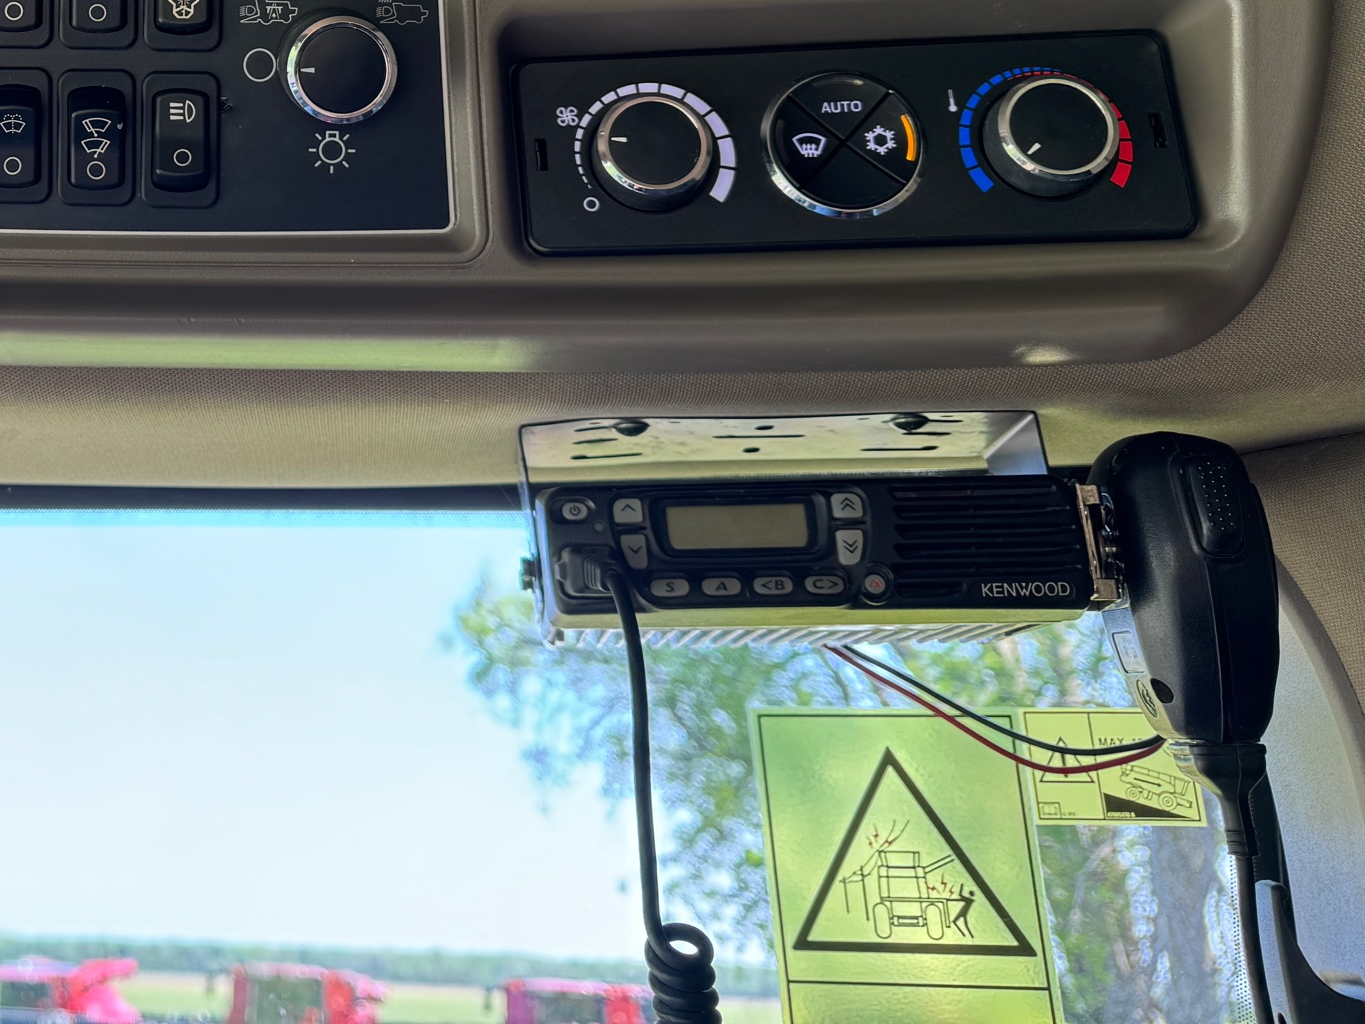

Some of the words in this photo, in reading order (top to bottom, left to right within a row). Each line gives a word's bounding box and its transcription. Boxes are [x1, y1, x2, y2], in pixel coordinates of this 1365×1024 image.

[821, 100, 862, 114] AUTO
[665, 581, 675, 592] S
[715, 581, 728, 592] A
[981, 581, 1070, 597] KENWOOD
